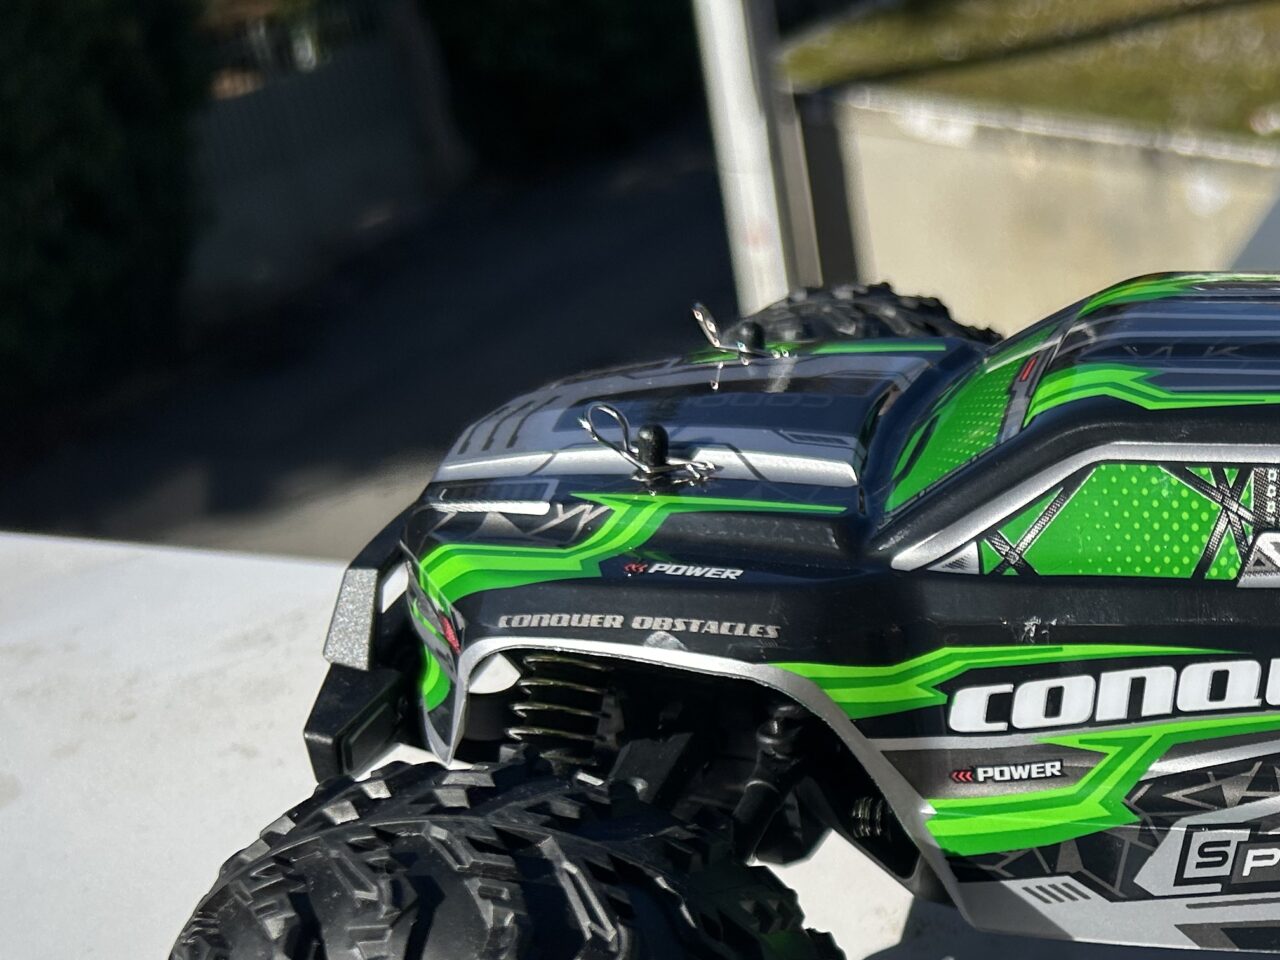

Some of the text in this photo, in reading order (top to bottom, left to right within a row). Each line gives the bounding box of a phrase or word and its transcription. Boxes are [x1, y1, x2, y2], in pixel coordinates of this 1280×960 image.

[648, 563, 744, 580] POWER
[498, 613, 781, 639] CONQUER OBSTACLES
[976, 761, 1063, 783] POWER
